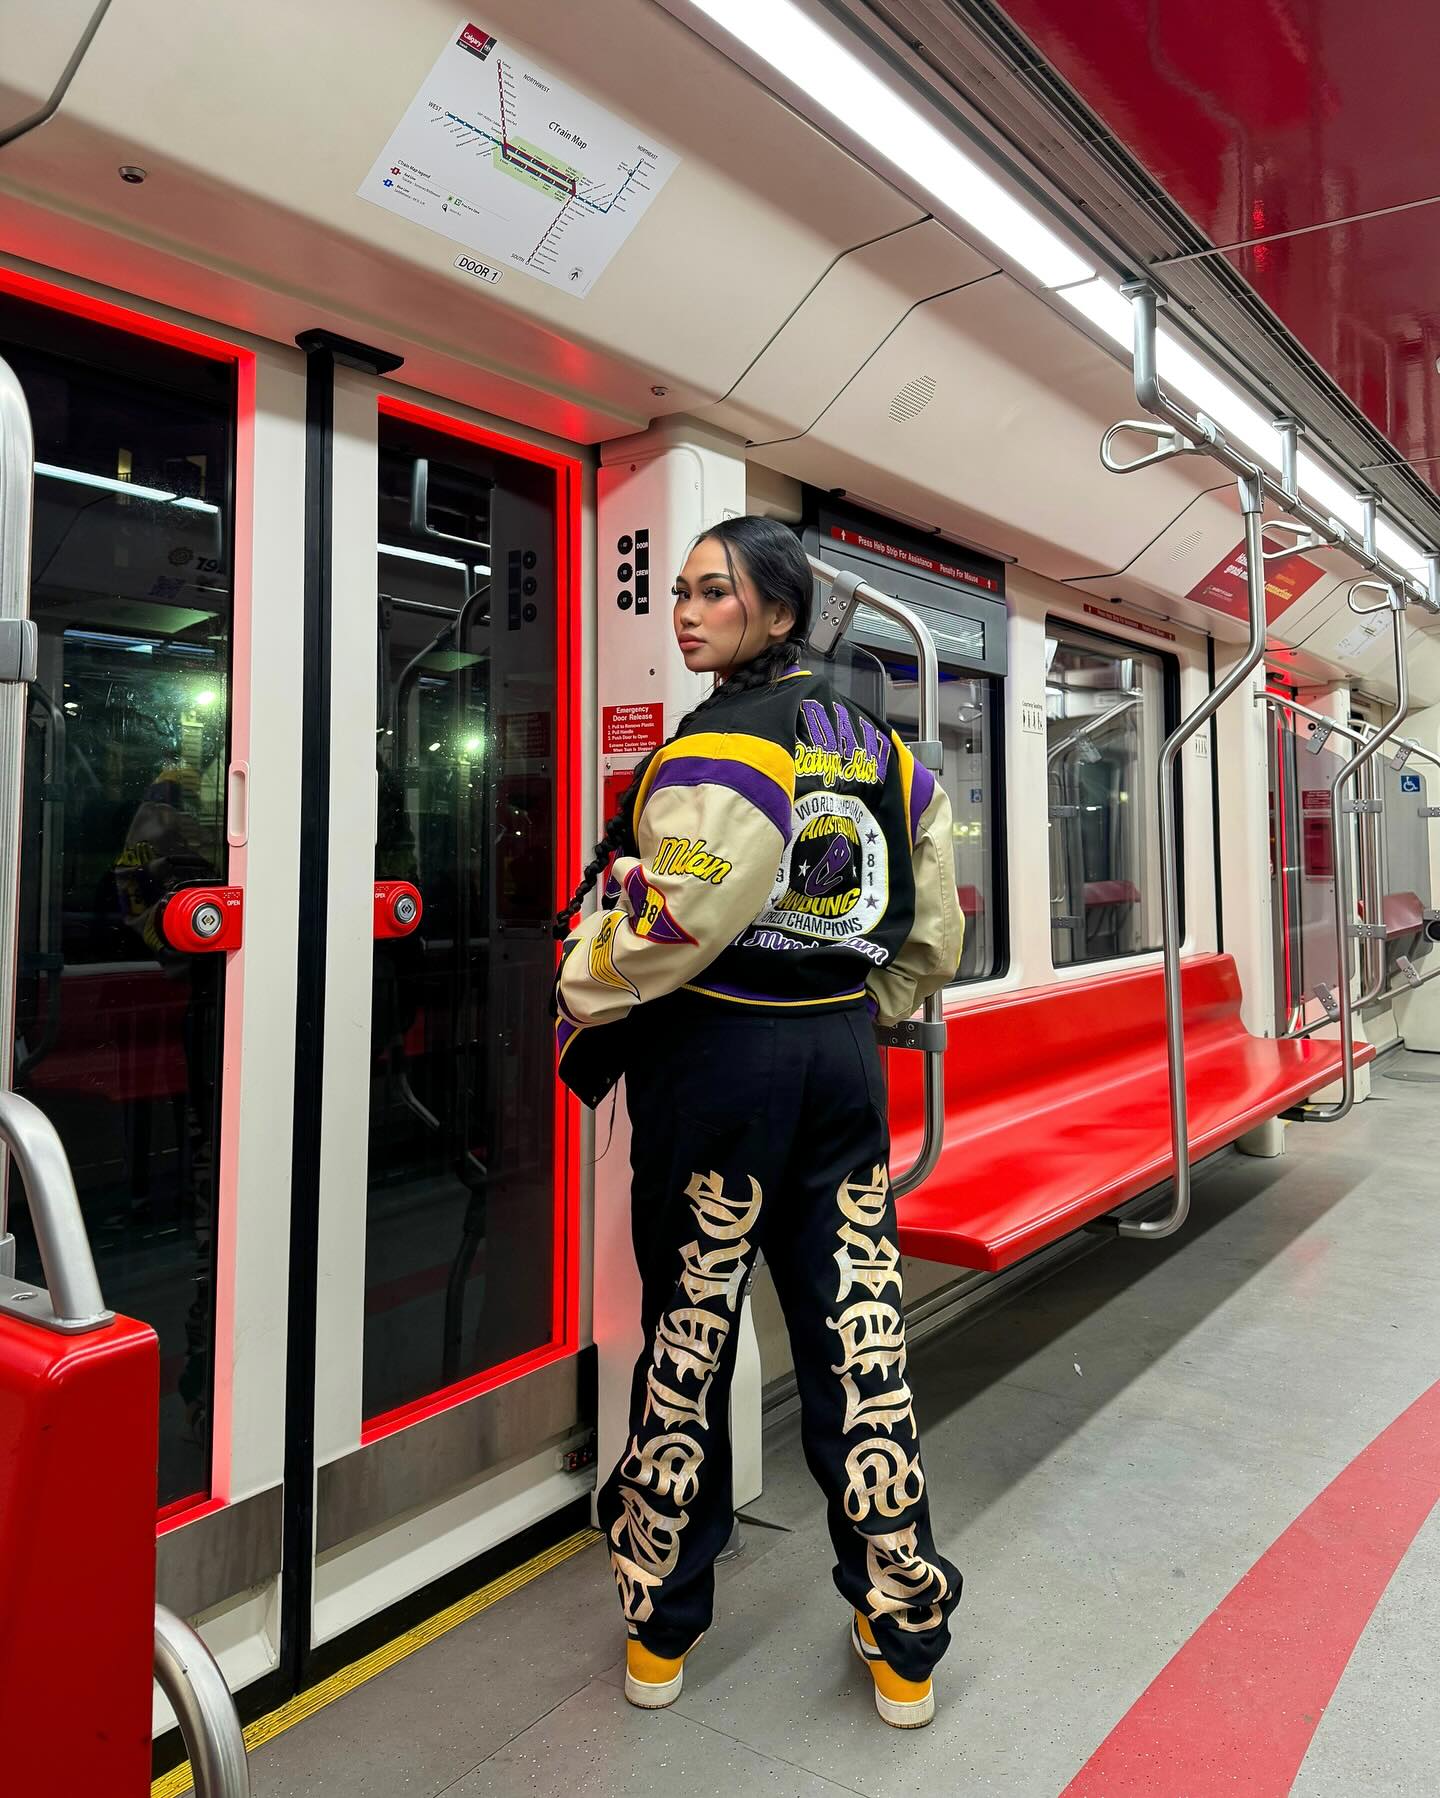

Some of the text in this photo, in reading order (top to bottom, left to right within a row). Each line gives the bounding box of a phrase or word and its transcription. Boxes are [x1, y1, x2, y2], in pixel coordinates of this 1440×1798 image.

[463, 31, 483, 48] Calgary
[523, 73, 550, 93] NORTHWEST
[428, 101, 442, 112] WEST
[548, 121, 588, 150] CTrain Map
[636, 145, 659, 161] NORTHEAST
[458, 257, 498, 281] DOOR 1
[858, 535, 873, 548] Press
[873, 540, 886, 553] Help
[886, 545, 899, 558] Strip
[899, 549, 907, 560] For
[907, 553, 933, 569] Assistance
[956, 569, 964, 579] For
[616, 706, 649, 714] Emergency
[795, 796, 834, 821] WORLD
[760, 911, 863, 937] ORLD CHAMPIONS
